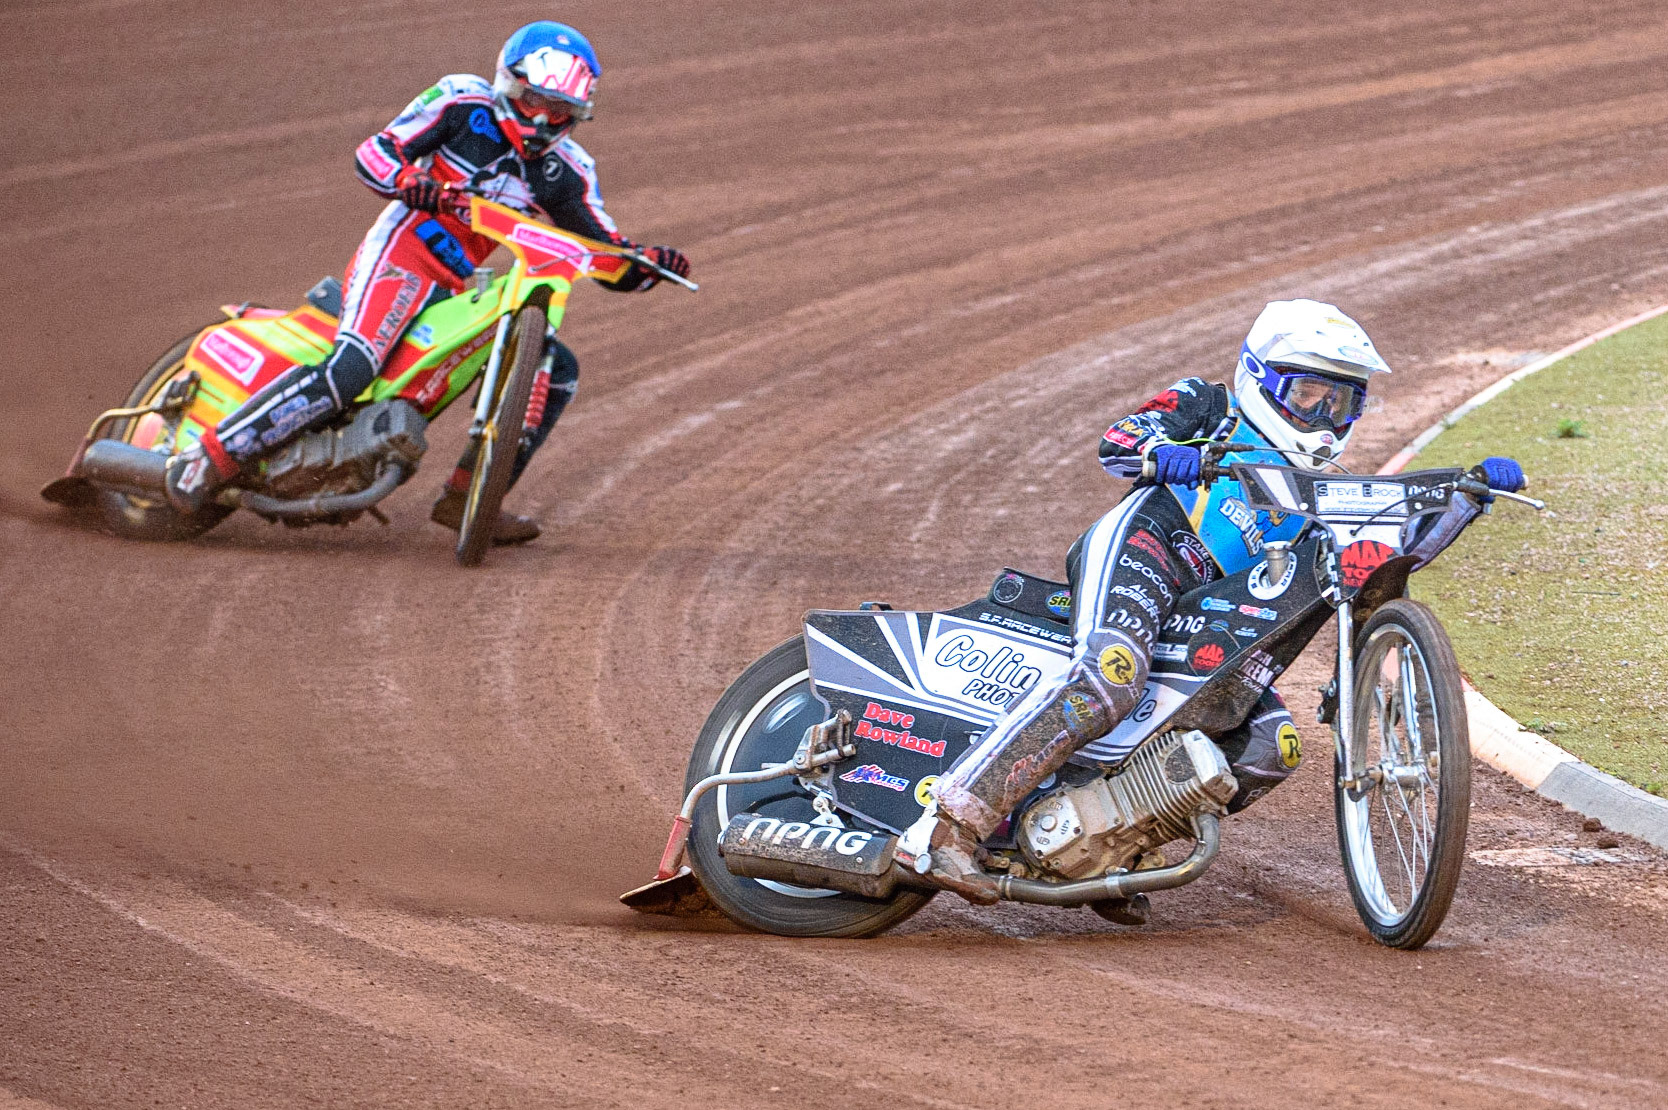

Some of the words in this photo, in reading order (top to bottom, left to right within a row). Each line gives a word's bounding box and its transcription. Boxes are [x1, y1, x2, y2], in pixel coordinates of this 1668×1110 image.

[1317, 484, 1358, 497] STEVE
[1219, 498, 1264, 555] DEVILS
[1183, 535, 1209, 560] STAKE
[1119, 553, 1173, 607] beacon
[979, 612, 1072, 644] S.F.RACEWEA
[934, 634, 1042, 692] Colin
[863, 701, 915, 729] Dave
[853, 720, 947, 757] Rowland
